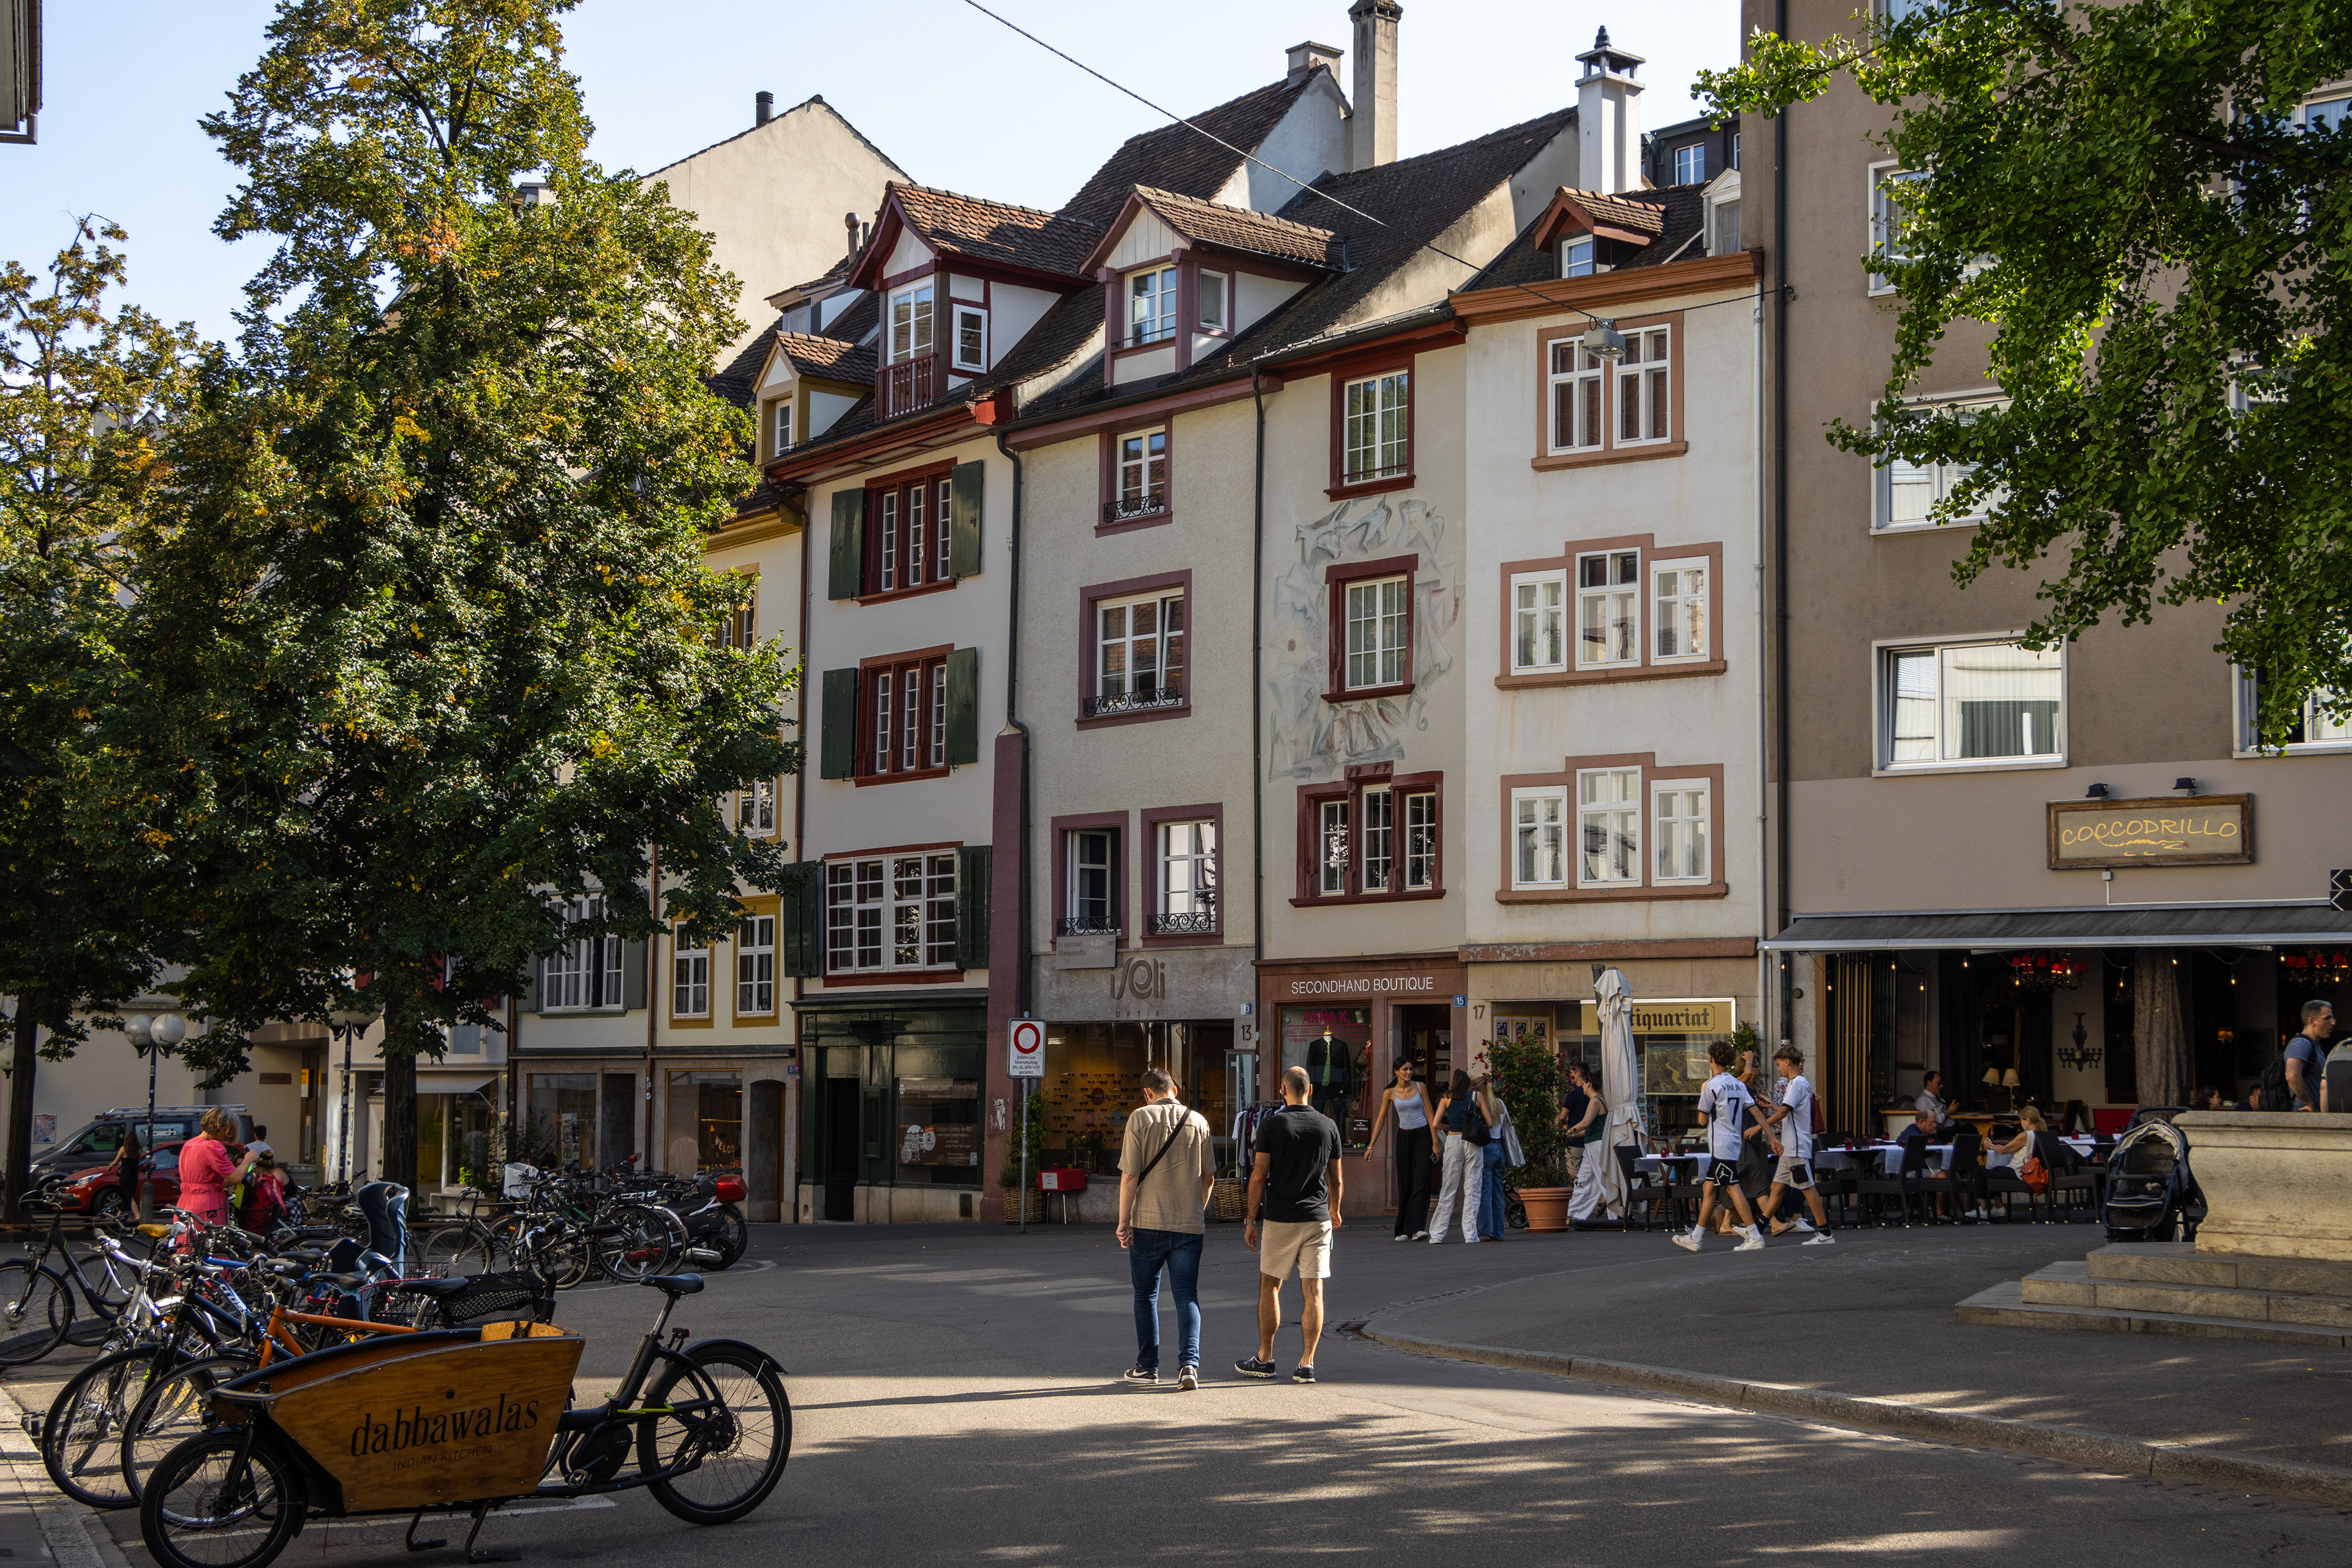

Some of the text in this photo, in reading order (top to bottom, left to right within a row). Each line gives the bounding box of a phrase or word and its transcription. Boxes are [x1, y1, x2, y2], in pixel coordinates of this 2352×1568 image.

[2062, 819, 2237, 845] COCCODRILLO
[1291, 976, 1434, 994] SECONDHAND BOUTIQUE
[1303, 1010, 1351, 1023] ANNA K.
[1473, 1005, 1485, 1019] 17
[1630, 1008, 1709, 1030] tiquariat
[1241, 1025, 1251, 1041] 13
[1728, 1097, 1740, 1126] 7
[220, 1283, 247, 1312] cros
[350, 1393, 540, 1457] dabbawalas
[394, 1445, 492, 1470] INDIAN KITCHEN
